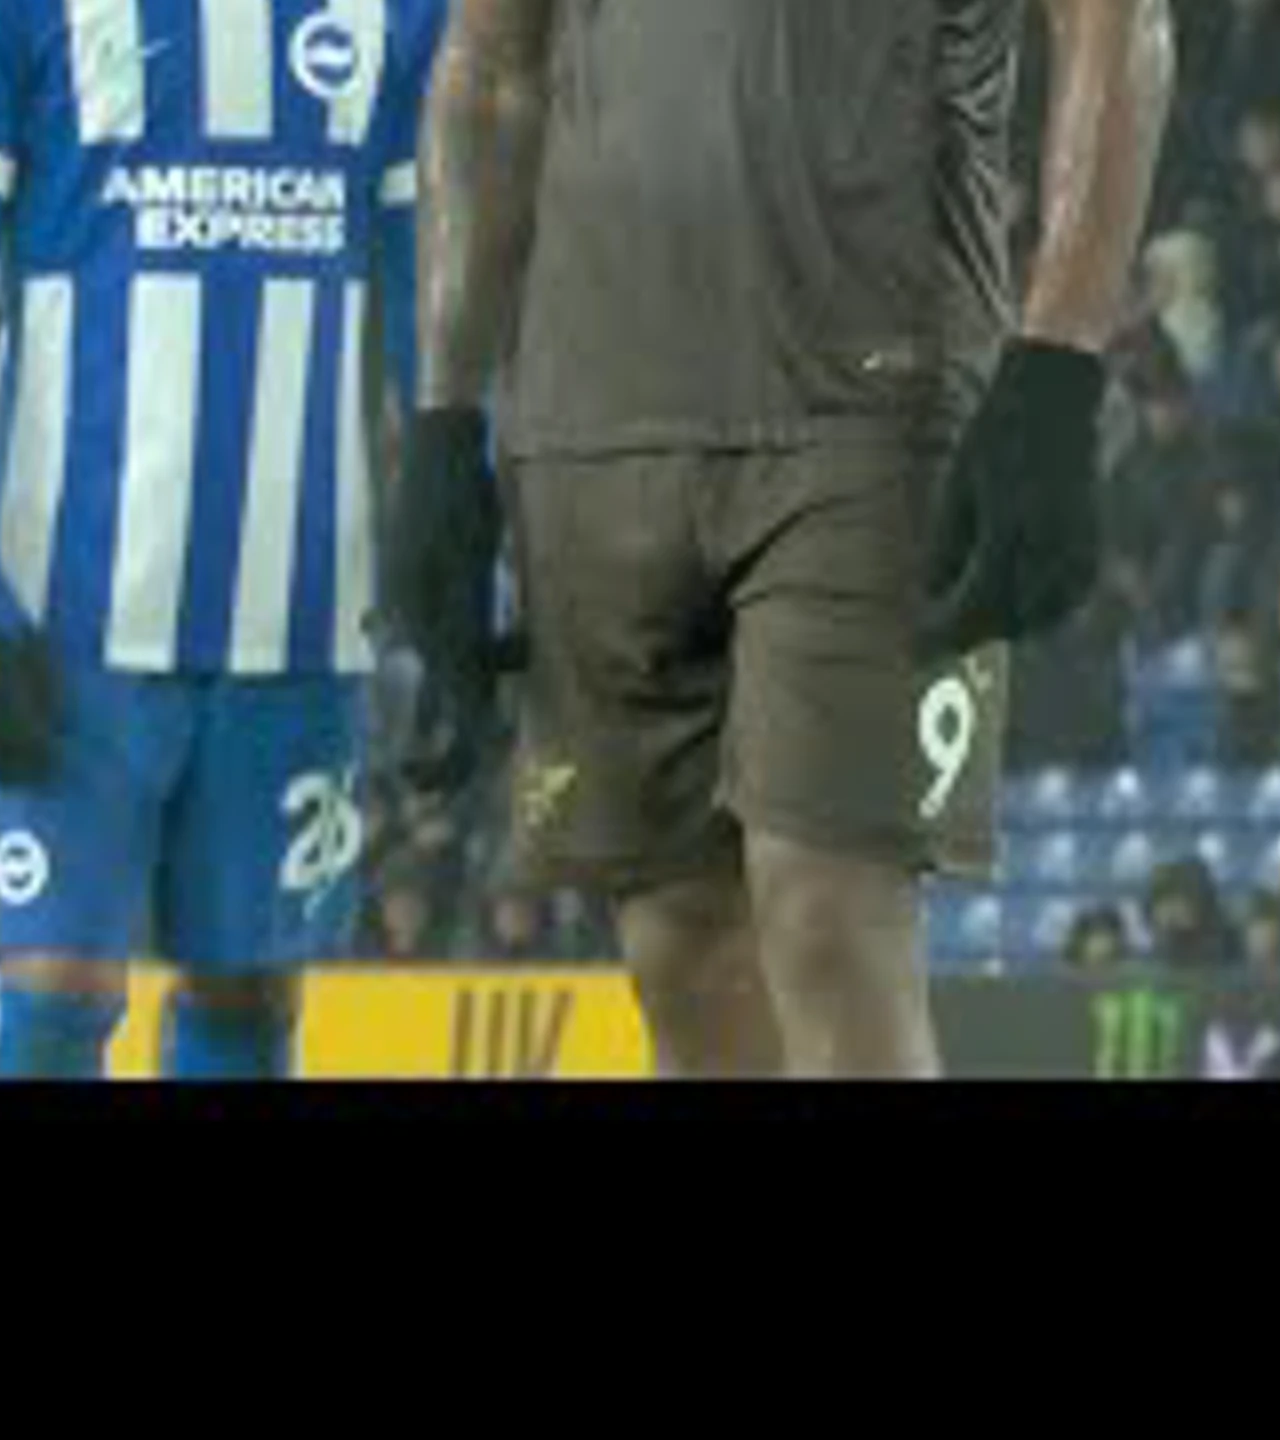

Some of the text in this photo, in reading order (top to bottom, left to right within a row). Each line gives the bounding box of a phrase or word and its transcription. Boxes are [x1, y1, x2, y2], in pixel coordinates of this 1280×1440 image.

[101, 166, 347, 211] AMERICAN
[134, 210, 347, 257] EXPRESS
[917, 675, 974, 819] 9
